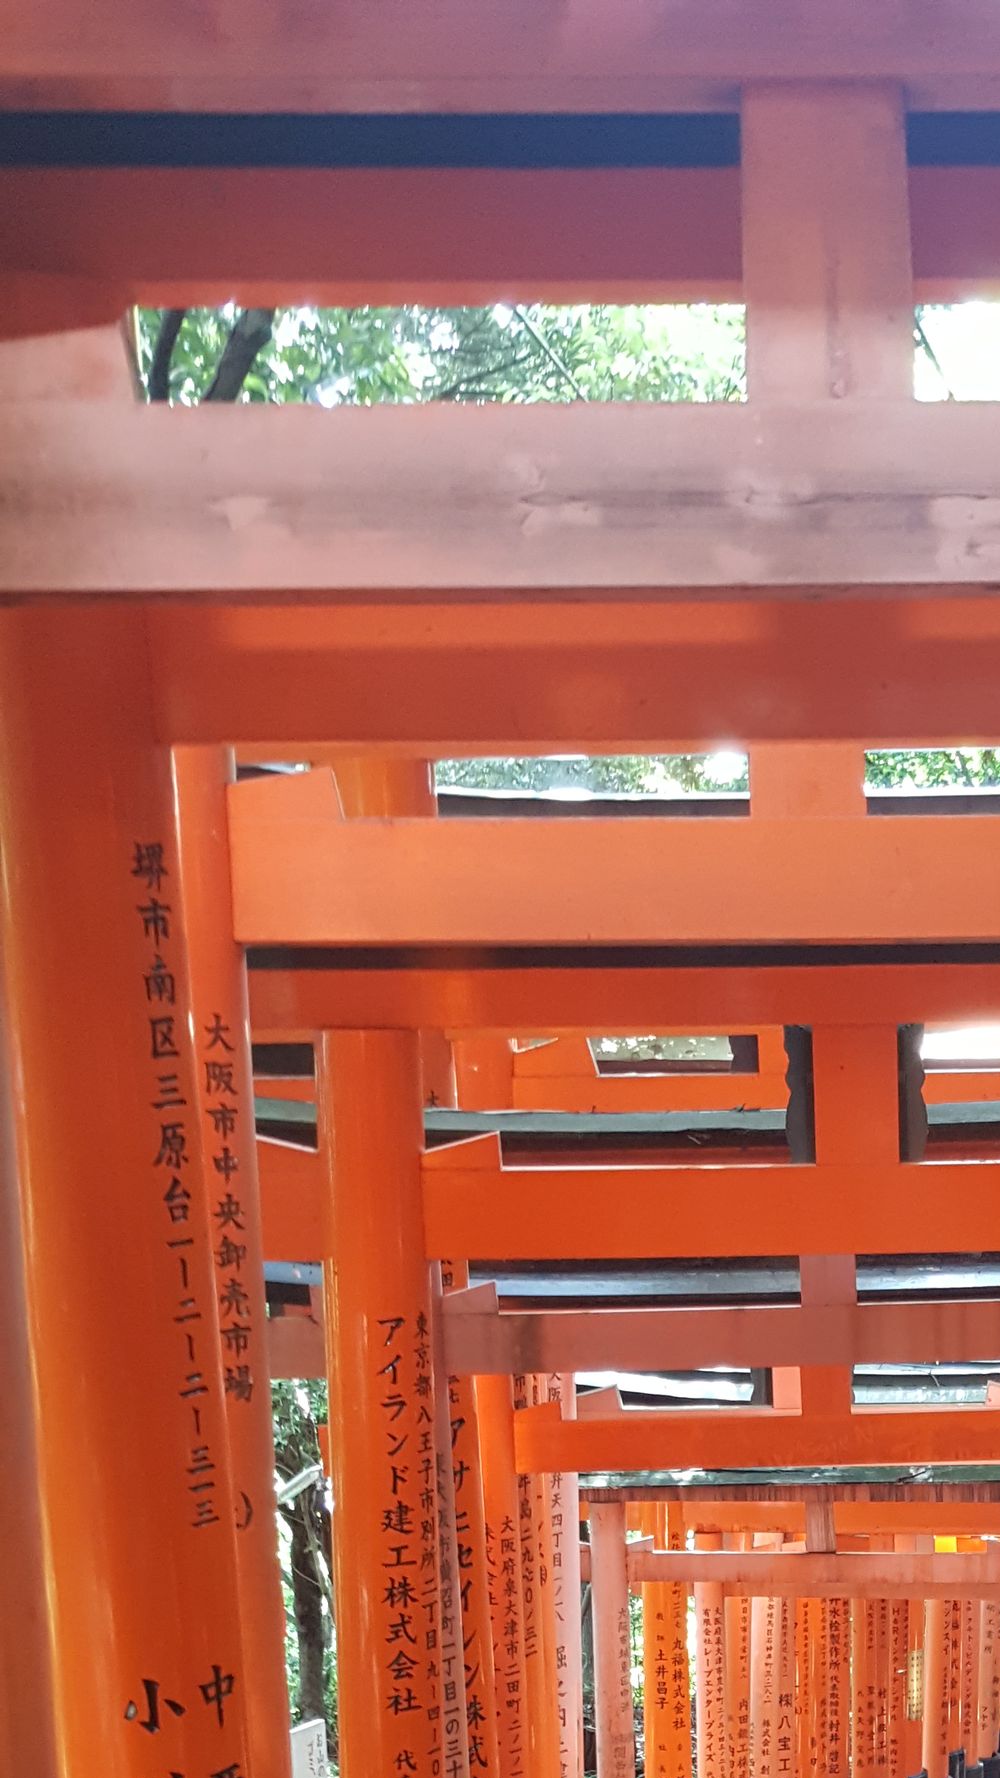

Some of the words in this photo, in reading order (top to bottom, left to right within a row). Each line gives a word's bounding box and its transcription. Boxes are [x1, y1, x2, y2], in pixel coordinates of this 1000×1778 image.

[203, 1012, 254, 1403] 大阪市中央卸売市場
[377, 1316, 423, 1716] アイランド建工株式会社
